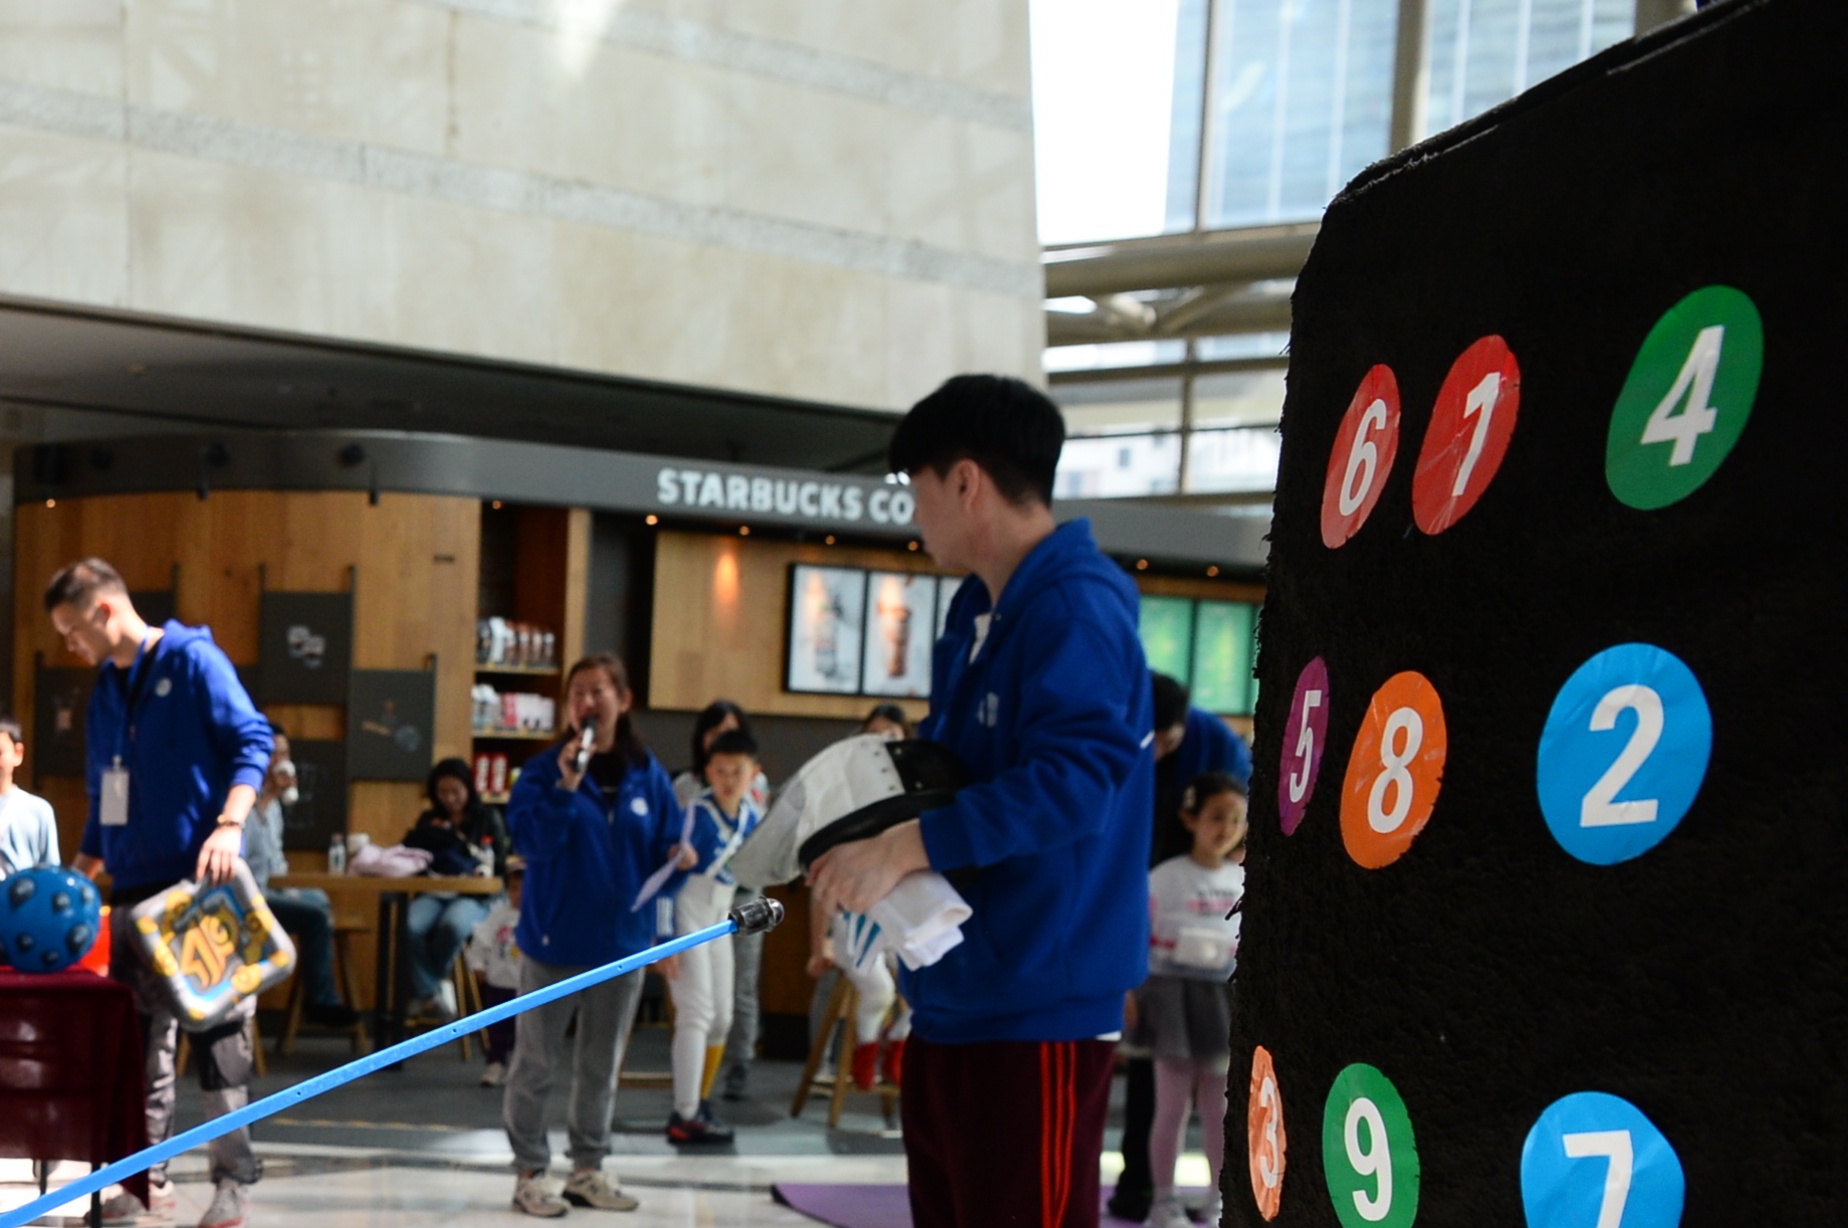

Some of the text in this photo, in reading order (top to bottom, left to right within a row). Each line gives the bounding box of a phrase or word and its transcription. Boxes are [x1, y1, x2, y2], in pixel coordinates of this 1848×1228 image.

[1339, 399, 1387, 516] 6
[1452, 372, 1501, 497] 1
[1641, 325, 1725, 466] 4
[657, 468, 915, 525] STARBUCKS CO
[1289, 690, 1322, 803] 5
[1367, 707, 1423, 834] 8
[1580, 684, 1664, 827] 2
[1260, 1077, 1279, 1188] 3
[1344, 1097, 1392, 1221] 9
